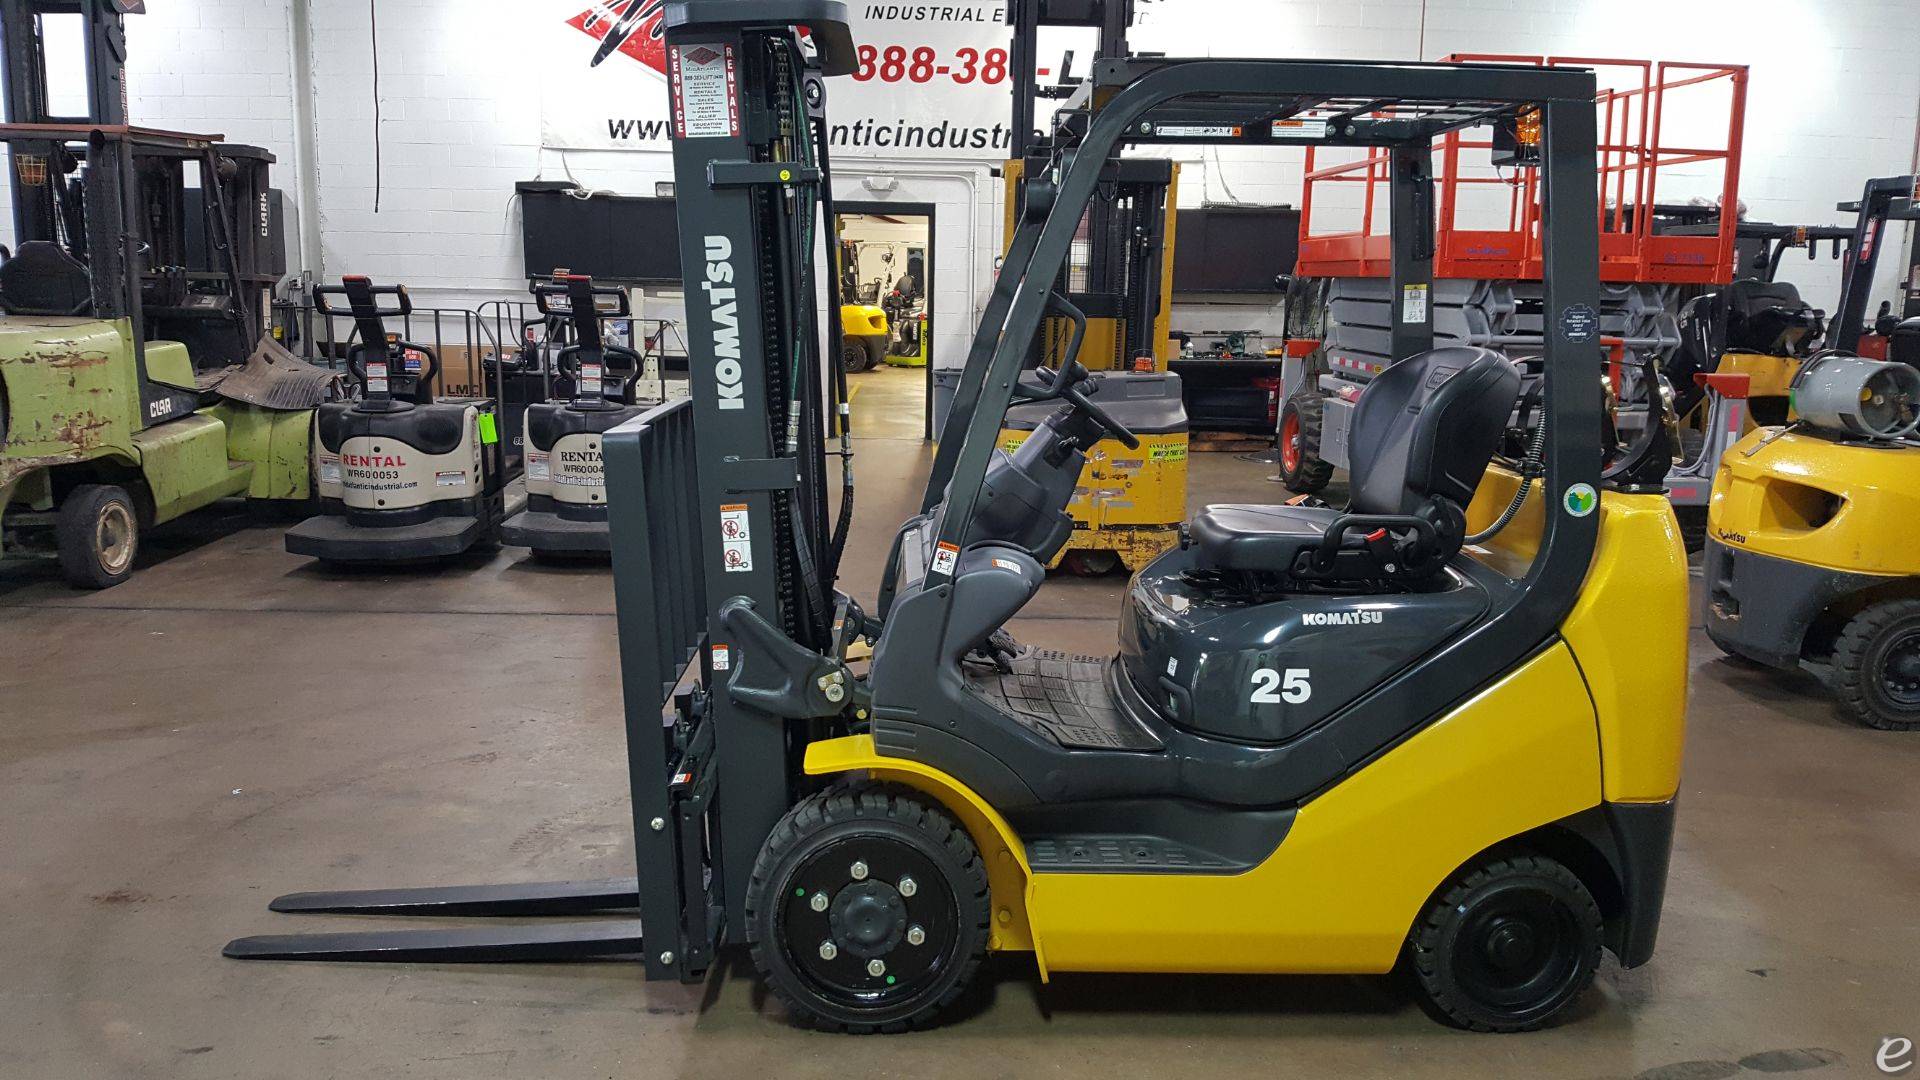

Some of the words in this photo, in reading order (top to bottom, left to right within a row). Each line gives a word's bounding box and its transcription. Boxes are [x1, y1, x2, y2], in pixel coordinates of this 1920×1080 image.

[865, 5, 984, 22] INDUSTRIAL
[672, 48, 684, 133] SERVICE
[725, 46, 738, 132] RENTALS
[260, 191, 268, 237] CLARK
[701, 235, 744, 410] KOMATSU
[343, 453, 407, 468] RENTAL
[560, 451, 605, 462] RENTA
[346, 468, 400, 480] WR600053
[563, 463, 605, 474] WR60004
[1302, 609, 1383, 626] KOMATSU
[1249, 668, 1312, 704] 25
